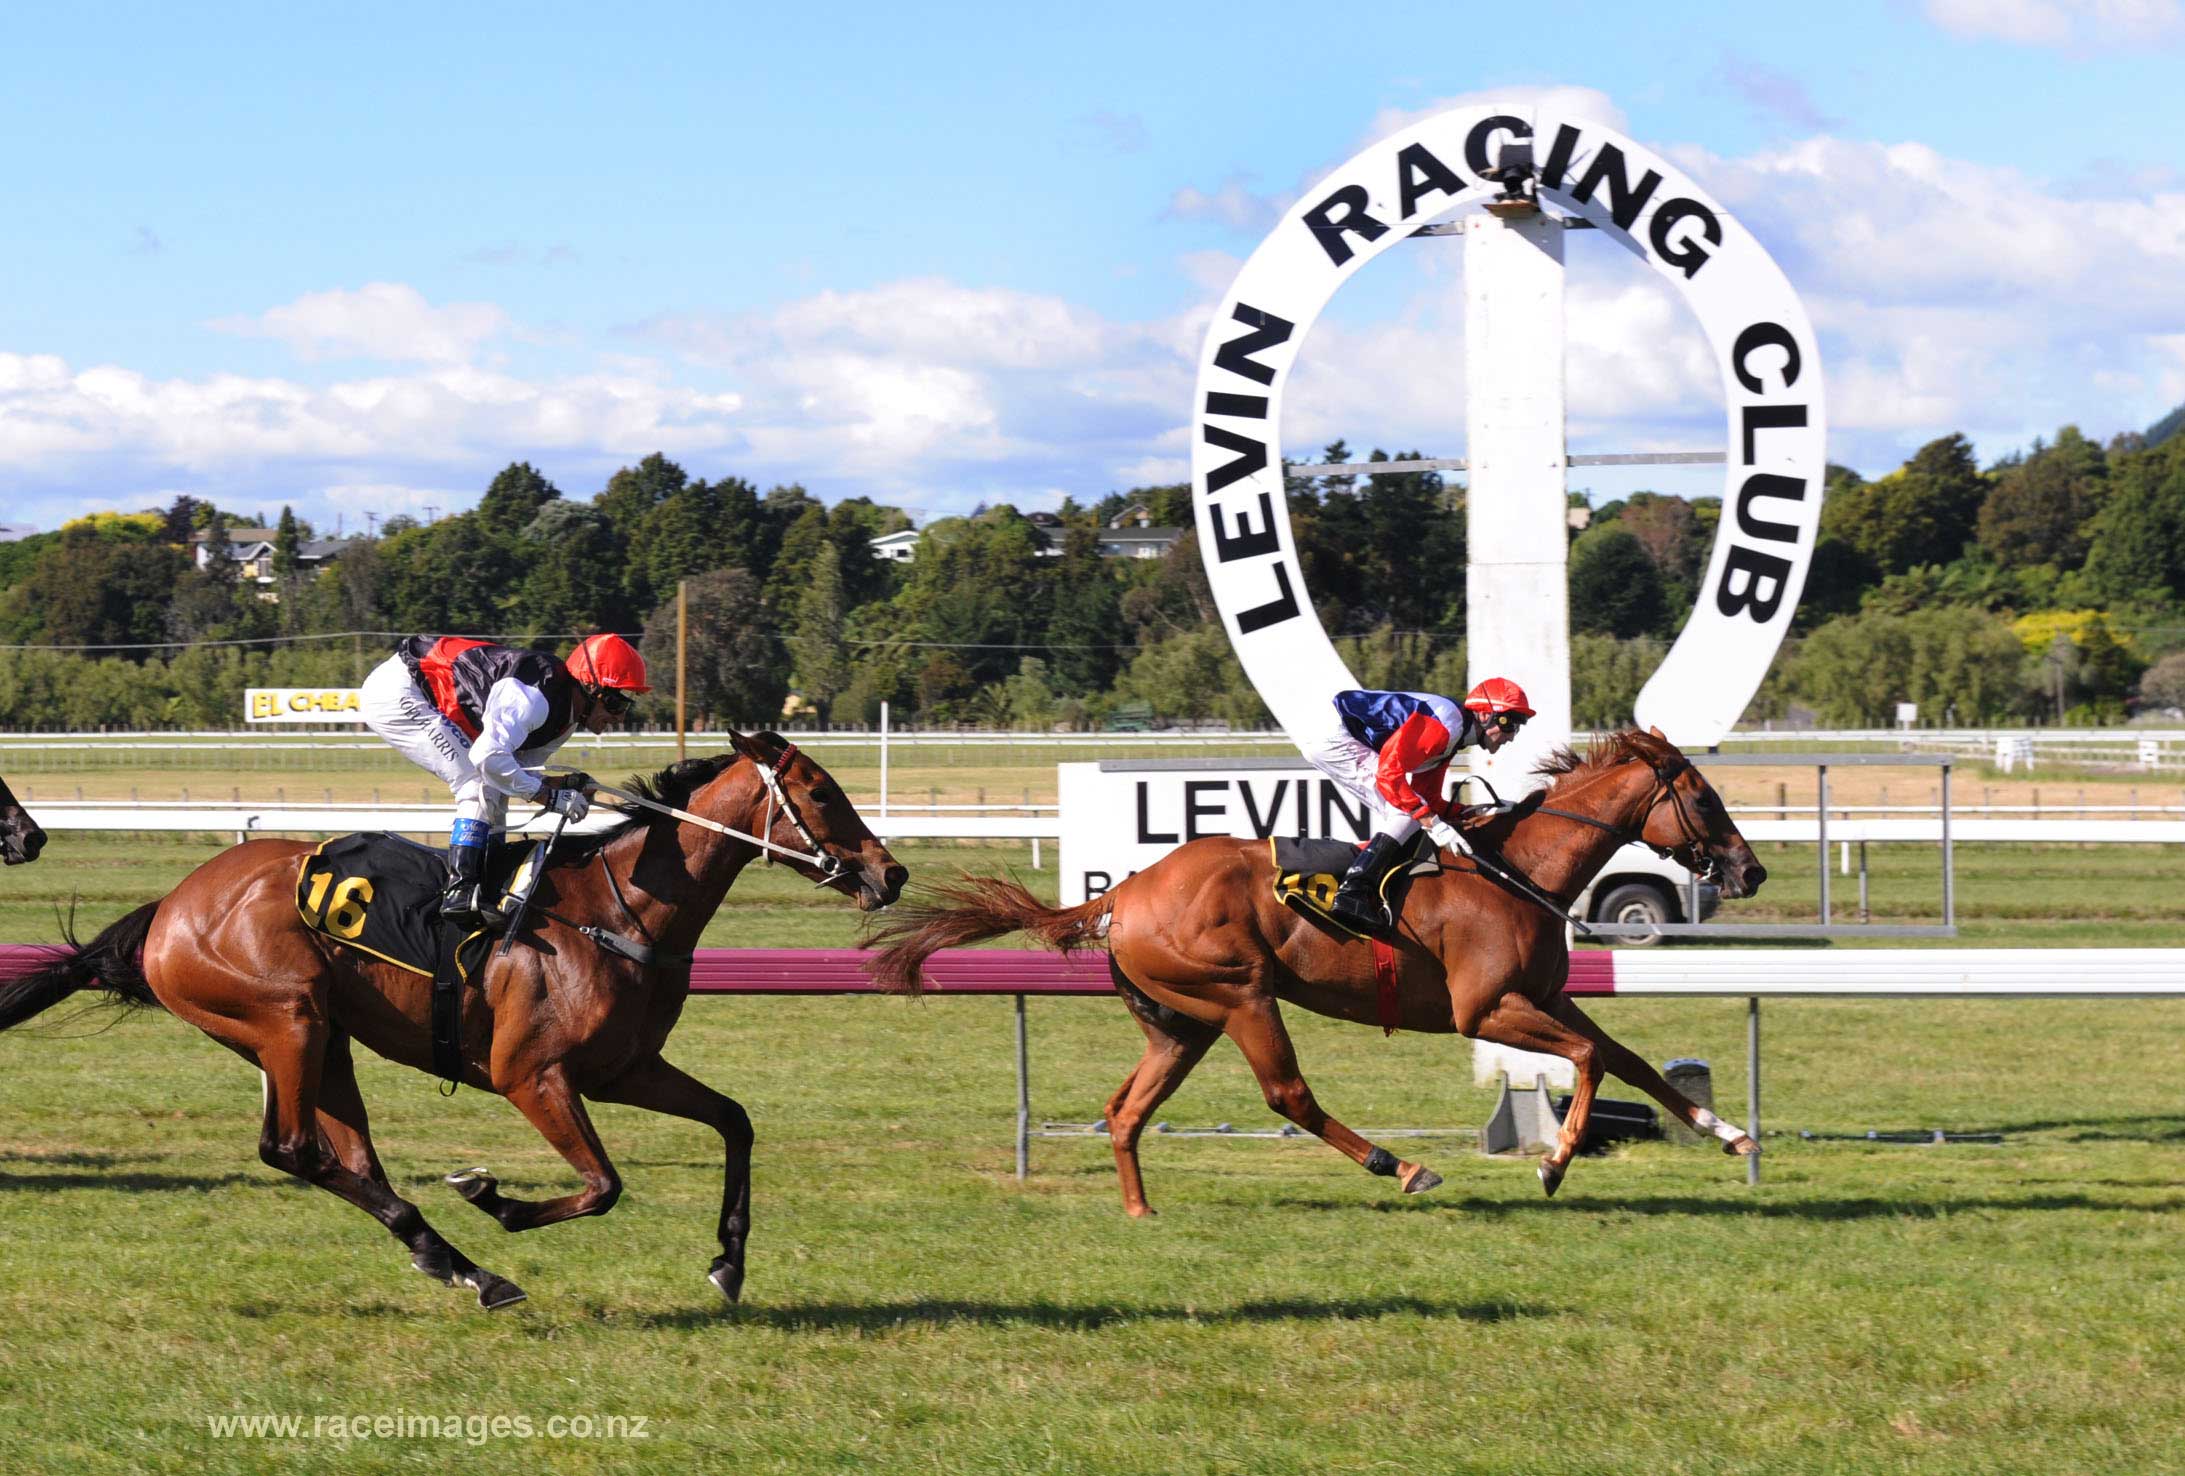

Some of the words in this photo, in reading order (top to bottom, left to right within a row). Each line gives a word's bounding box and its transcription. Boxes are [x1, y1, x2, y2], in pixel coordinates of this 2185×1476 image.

[1203, 301, 1300, 634] LEVIN
[1302, 115, 1723, 280] RACING
[1716, 321, 1808, 625] CLUB
[253, 692, 284, 719] EL
[289, 692, 361, 713] CHEA
[1137, 779, 1371, 844] LEVIN
[302, 872, 374, 939] 16
